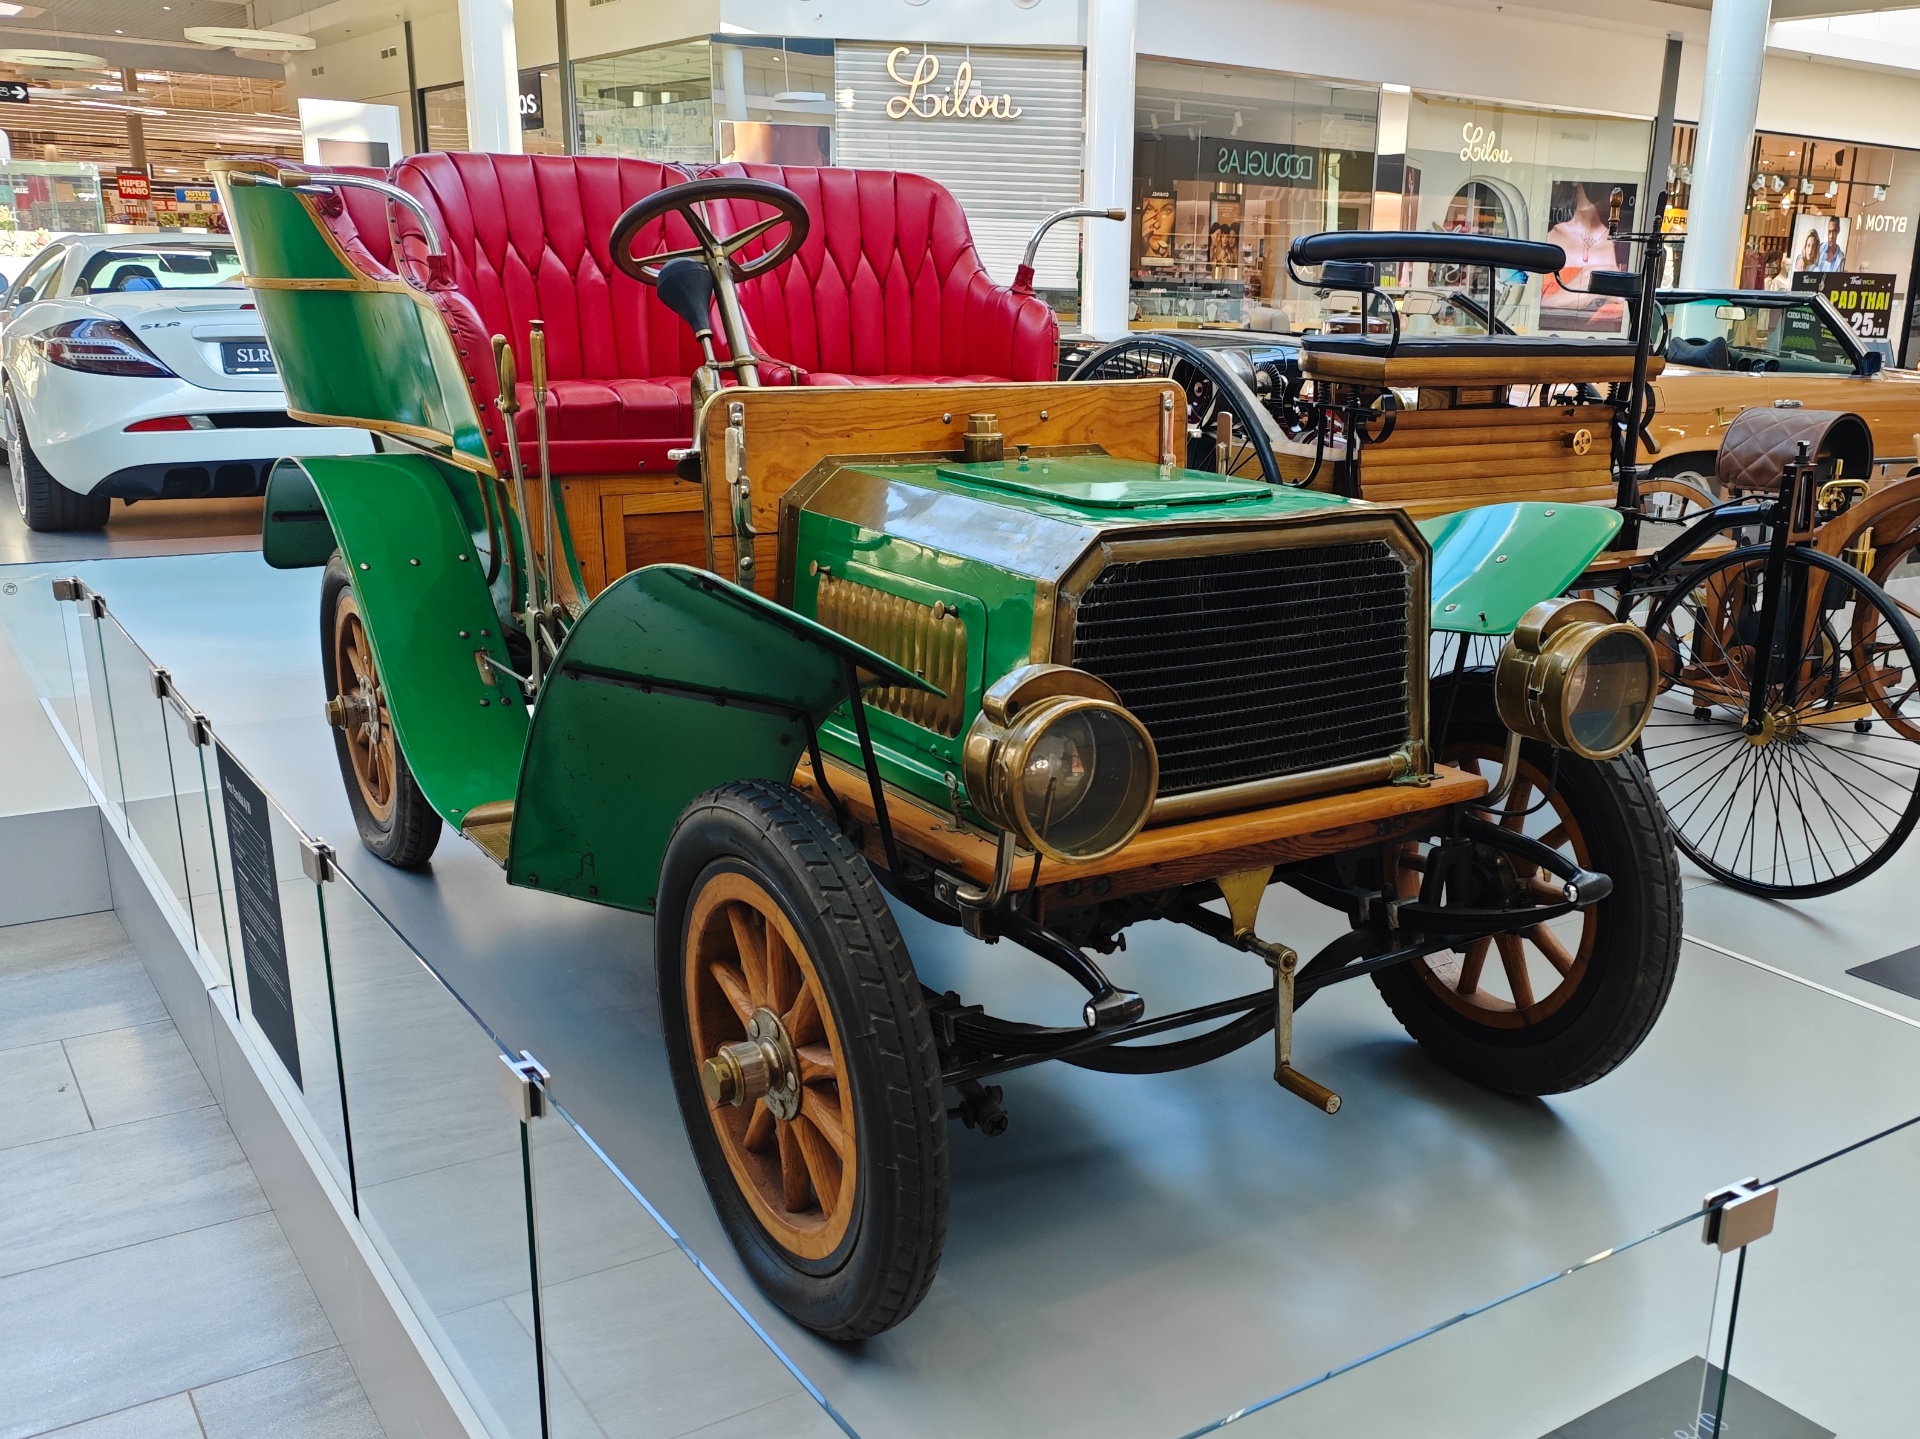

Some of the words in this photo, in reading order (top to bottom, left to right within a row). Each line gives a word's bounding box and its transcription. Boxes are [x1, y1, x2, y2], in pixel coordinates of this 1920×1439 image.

[886, 47, 1023, 119] Lilou
[1459, 121, 1513, 164] Lilou
[118, 178, 148, 188] HIPER
[119, 186, 149, 196] TANIO
[1830, 290, 1858, 310] PAD
[1860, 291, 1891, 311] THAI
[140, 321, 182, 330] SLR
[1851, 312, 1875, 336] 25
[237, 348, 272, 363] SLR
